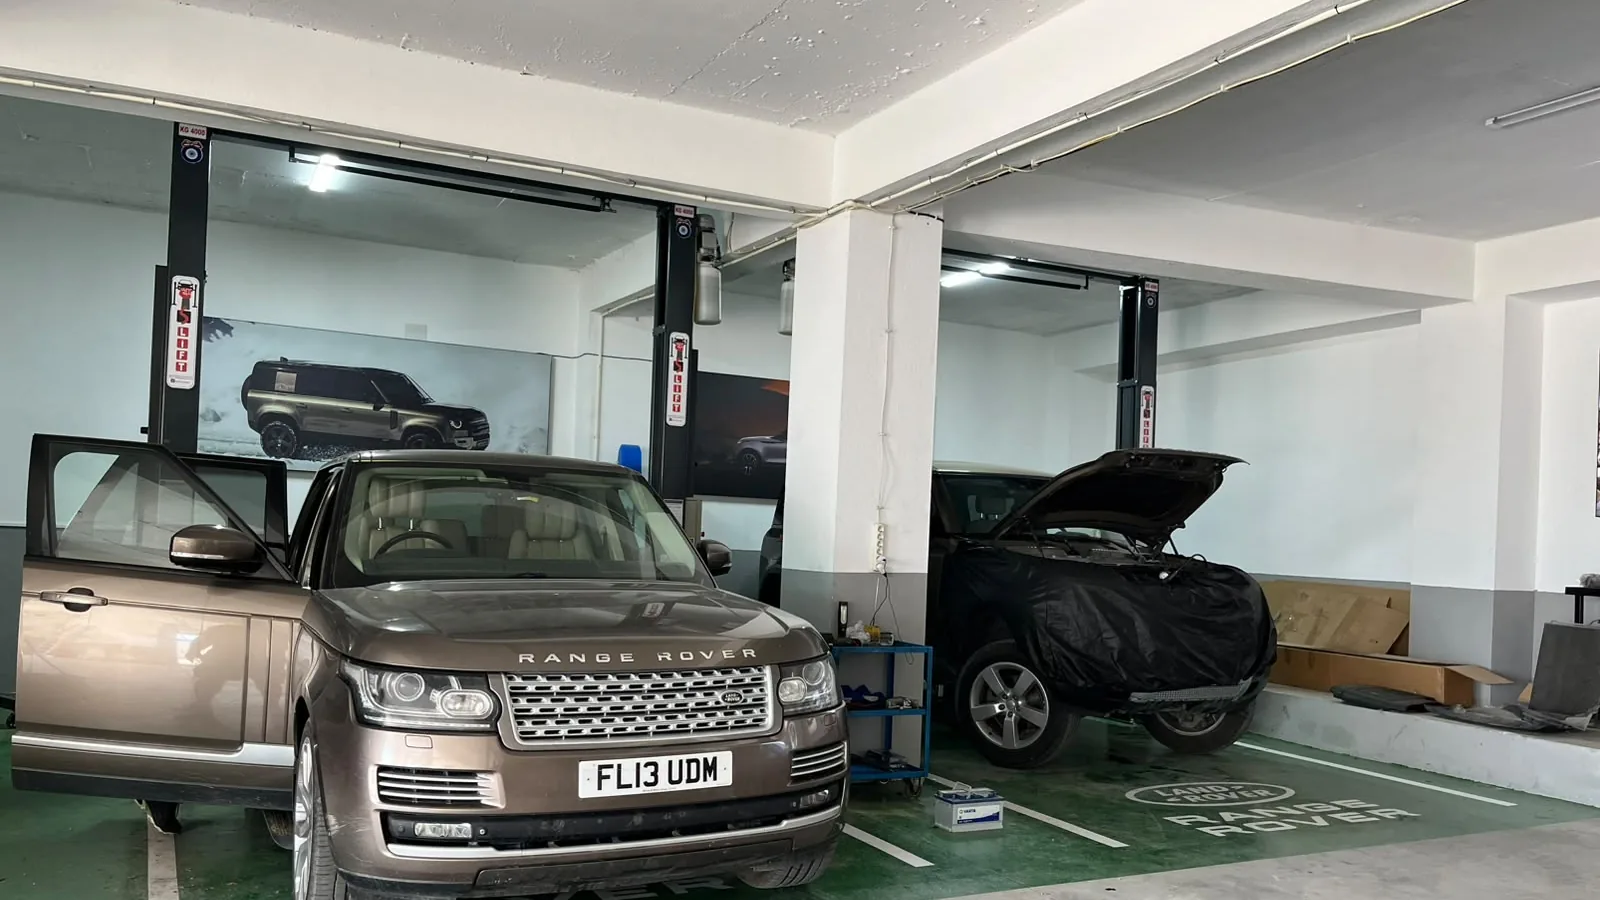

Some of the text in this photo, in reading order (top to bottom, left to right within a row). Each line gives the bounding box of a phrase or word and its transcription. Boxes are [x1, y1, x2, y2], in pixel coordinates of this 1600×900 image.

[176, 327, 188, 372] LIFT
[518, 648, 757, 664] RANGE ROVER
[597, 756, 717, 791] FL13 UDM
[1154, 785, 1230, 797] LAND
[1186, 789, 1276, 803] ROVER
[1163, 799, 1386, 826] RANGE
[1195, 808, 1421, 837] ROVER
